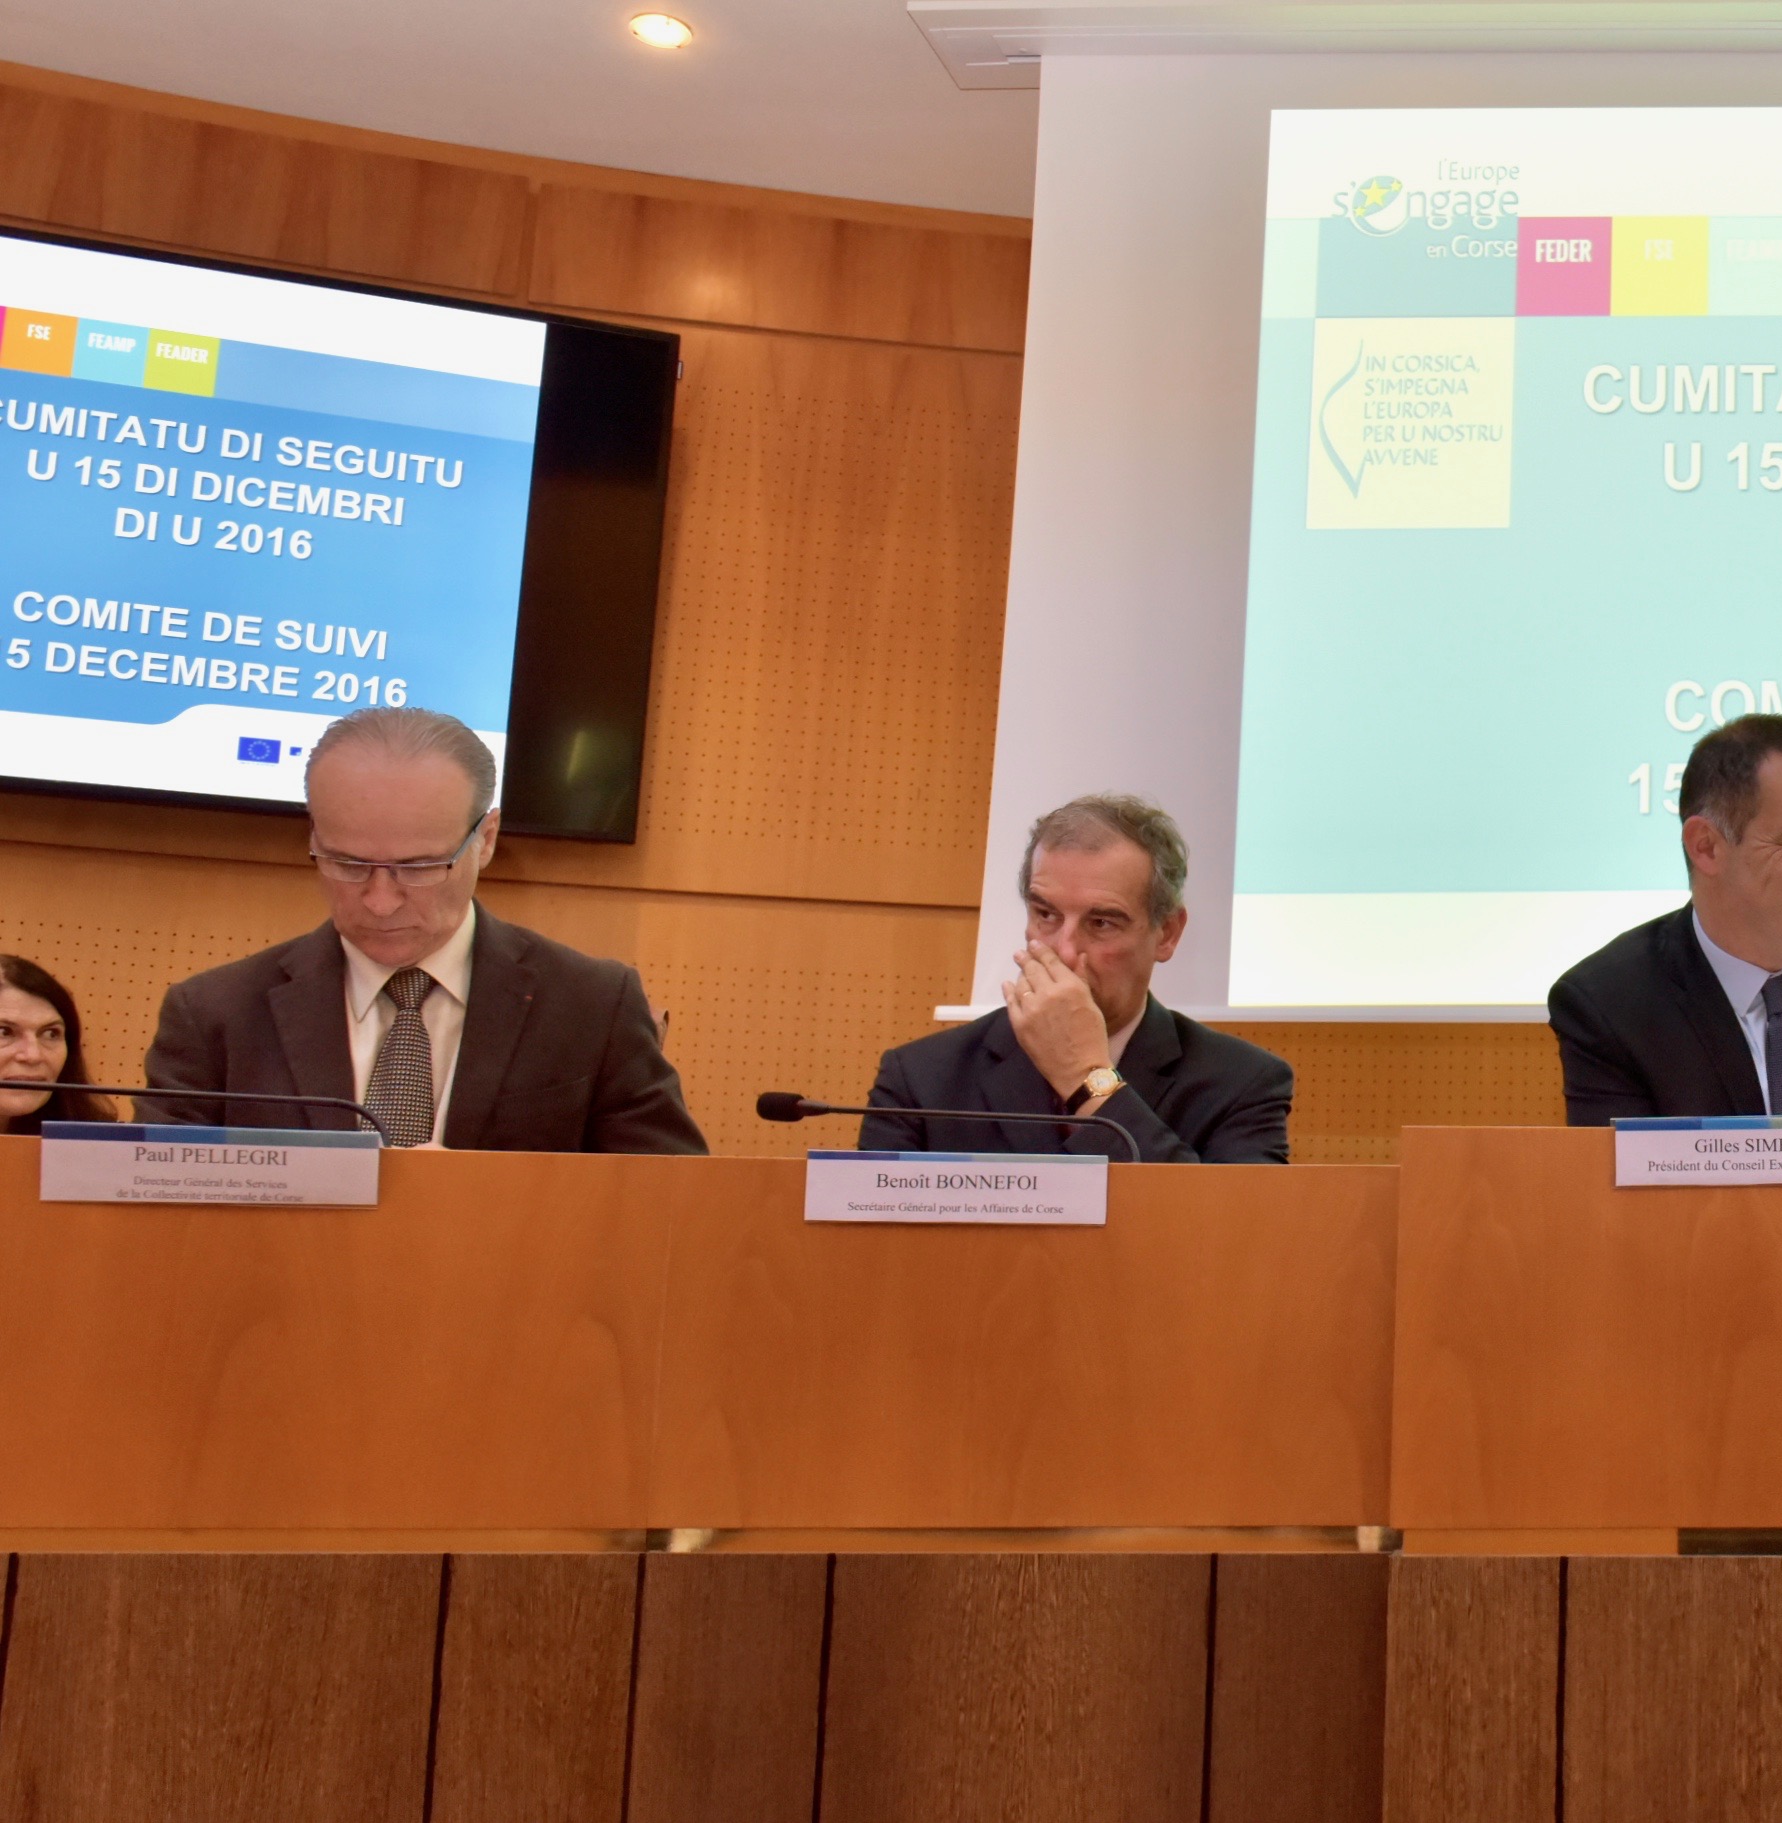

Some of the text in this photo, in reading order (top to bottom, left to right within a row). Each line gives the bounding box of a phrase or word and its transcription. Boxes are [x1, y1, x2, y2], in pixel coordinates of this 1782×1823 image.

[1438, 158, 1520, 183] l'Europe
[1427, 234, 1518, 258] en Corse
[1535, 239, 1592, 262] FEDER
[1644, 239, 1675, 261] FSE
[27, 323, 209, 365] FSE FEAMP FEADER
[1366, 355, 1480, 374] IN CORSICA,
[1365, 377, 1469, 396] S'IMPEGNA
[1364, 400, 1453, 419] L'EUROPA
[1363, 424, 1503, 443] PER U NOSTRU
[0, 399, 464, 489] UMITATU DI SEGUITU
[1363, 447, 1440, 466] AVVENE
[1664, 442, 1702, 491] U
[27, 449, 405, 526] U 15 DI DICEMBRI
[115, 507, 312, 560] DI U 2016
[13, 591, 388, 661] COMITE DE SUIVI
[45, 641, 300, 697] DECEMBRE
[312, 670, 408, 708] 2016
[135, 1146, 288, 1166] Paul PELLEGRI
[1694, 1138, 1740, 1154] Gilles
[1648, 1160, 1700, 1172] Président
[1704, 1160, 1718, 1171] du
[1721, 1159, 1765, 1171] Conseil
[134, 1176, 288, 1190] Directeur Général des Services
[876, 1173, 1038, 1190] Benoît BONNEFOI
[848, 1202, 1064, 1215] Secrétaire Général pour les Affaires de Corse
